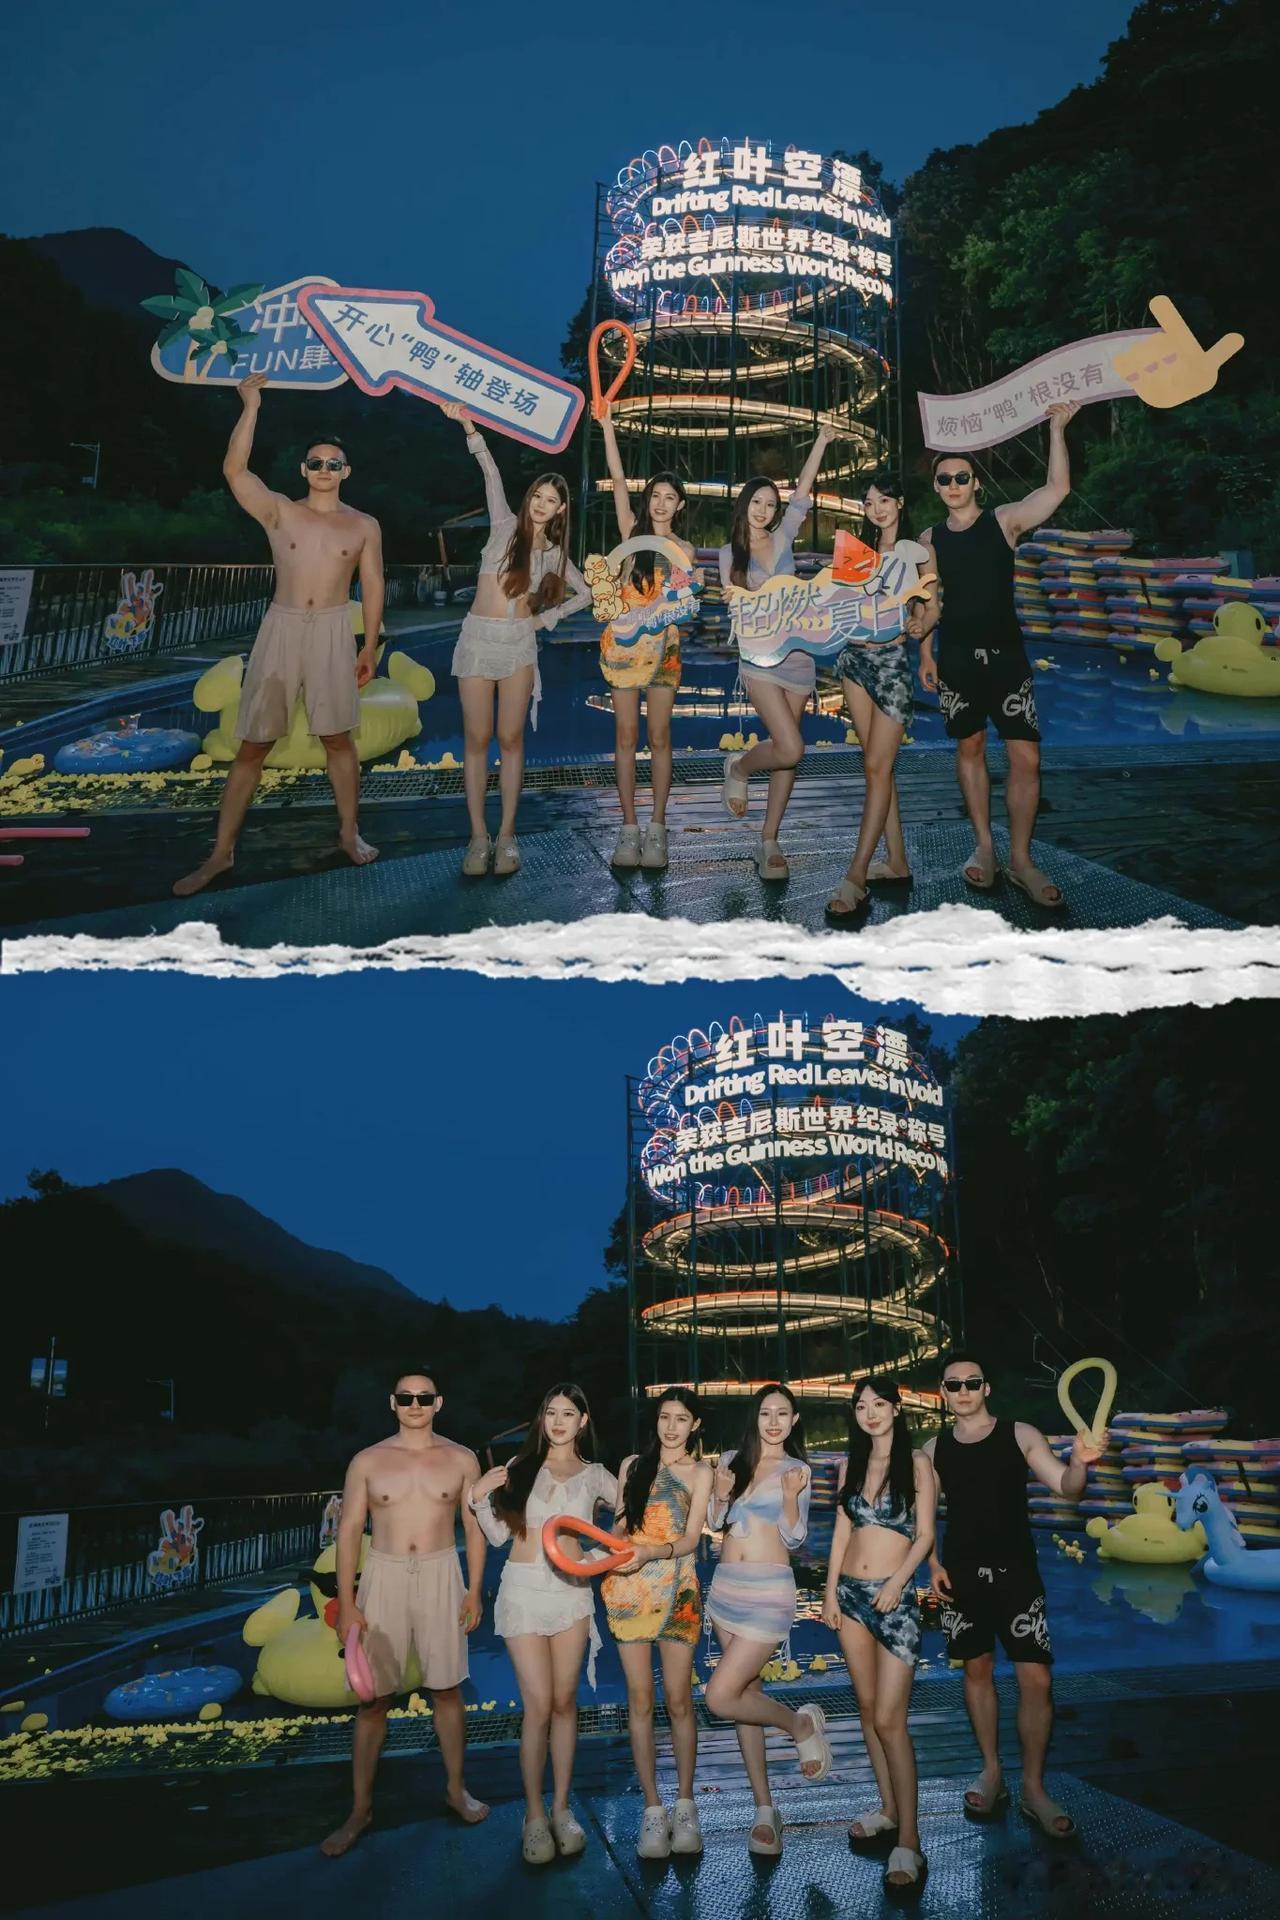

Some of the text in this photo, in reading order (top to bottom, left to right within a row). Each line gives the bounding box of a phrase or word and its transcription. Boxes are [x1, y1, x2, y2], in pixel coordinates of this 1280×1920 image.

[683, 146, 861, 204] 红叶空漂
[652, 185, 892, 238] Drifting Red Leaves in Void
[611, 267, 648, 291] Won
[652, 259, 687, 281] the
[687, 253, 785, 276] Guinness
[785, 255, 847, 281] World
[249, 294, 319, 343] 冲
[727, 582, 907, 650] 超燃夏日
[715, 1019, 909, 1072] 红叶空漂
[685, 1063, 943, 1106] Drifting Red Leaves in Void
[648, 1160, 686, 1188] Won
[689, 1151, 724, 1174] the
[725, 1137, 827, 1166] Guinness
[829, 1135, 893, 1160] World
